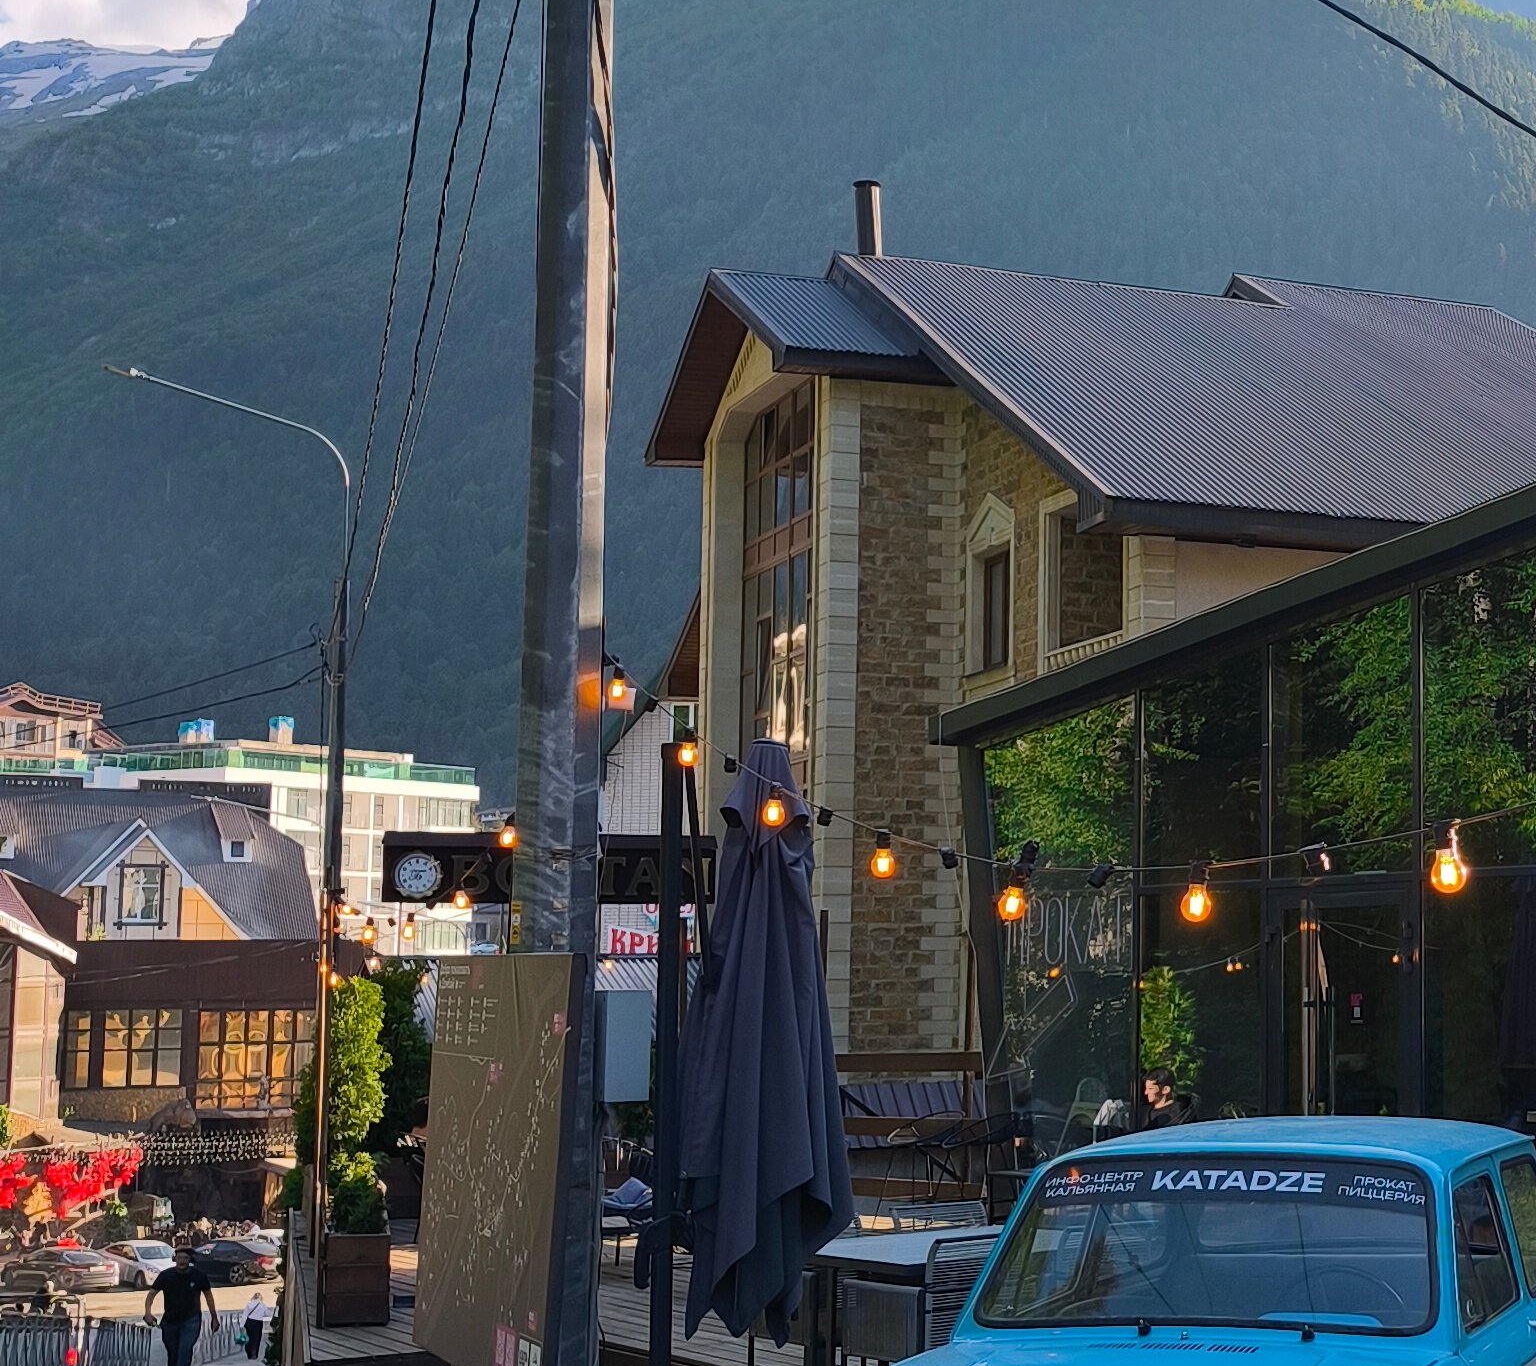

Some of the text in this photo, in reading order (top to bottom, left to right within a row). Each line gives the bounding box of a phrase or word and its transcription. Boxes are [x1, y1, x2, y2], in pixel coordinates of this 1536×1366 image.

[1045, 1182, 1136, 1198] КАЛЬЯННАЯ
[1151, 1169, 1326, 1193] KATADZE
[1353, 1175, 1417, 1191] ПРОКАТ
[1337, 1185, 1426, 1206] ПИЦЦЕРИЯ
